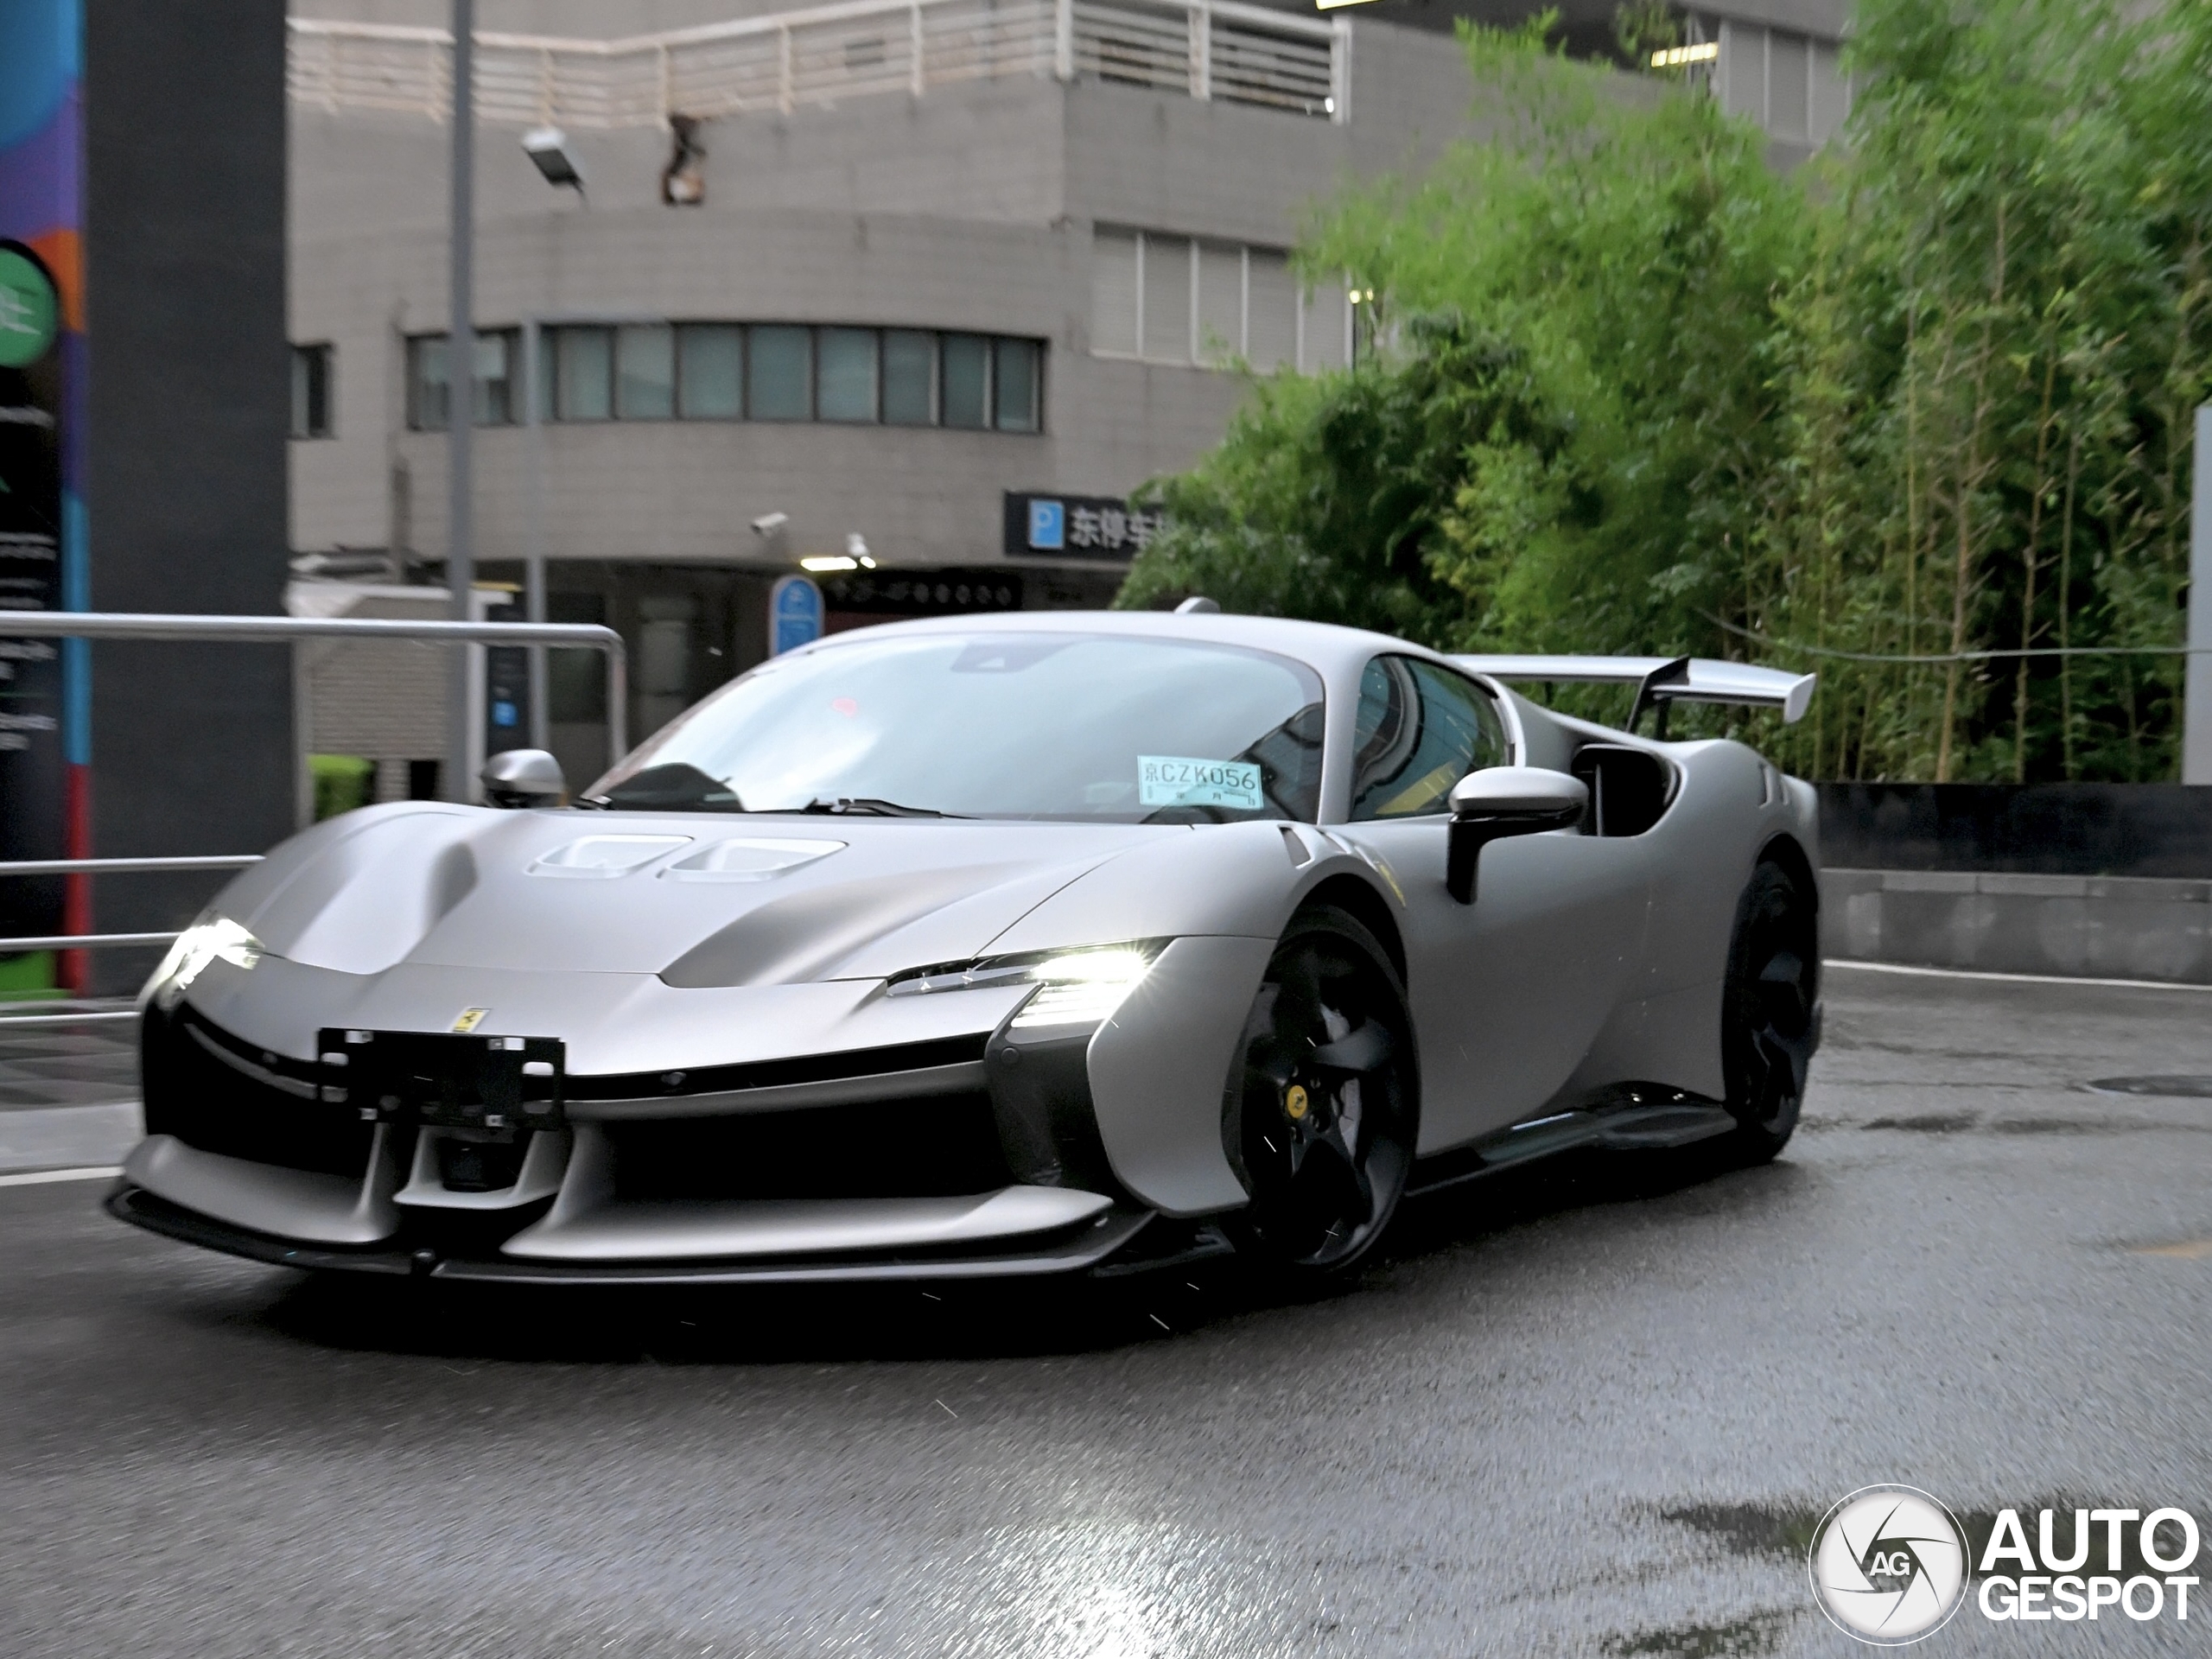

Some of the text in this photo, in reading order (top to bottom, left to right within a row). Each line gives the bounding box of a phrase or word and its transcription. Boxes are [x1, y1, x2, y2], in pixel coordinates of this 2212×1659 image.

[1037, 505, 1052, 540] P
[1070, 506, 1168, 553] 东停车
[1145, 763, 1256, 791] 京CZK056
